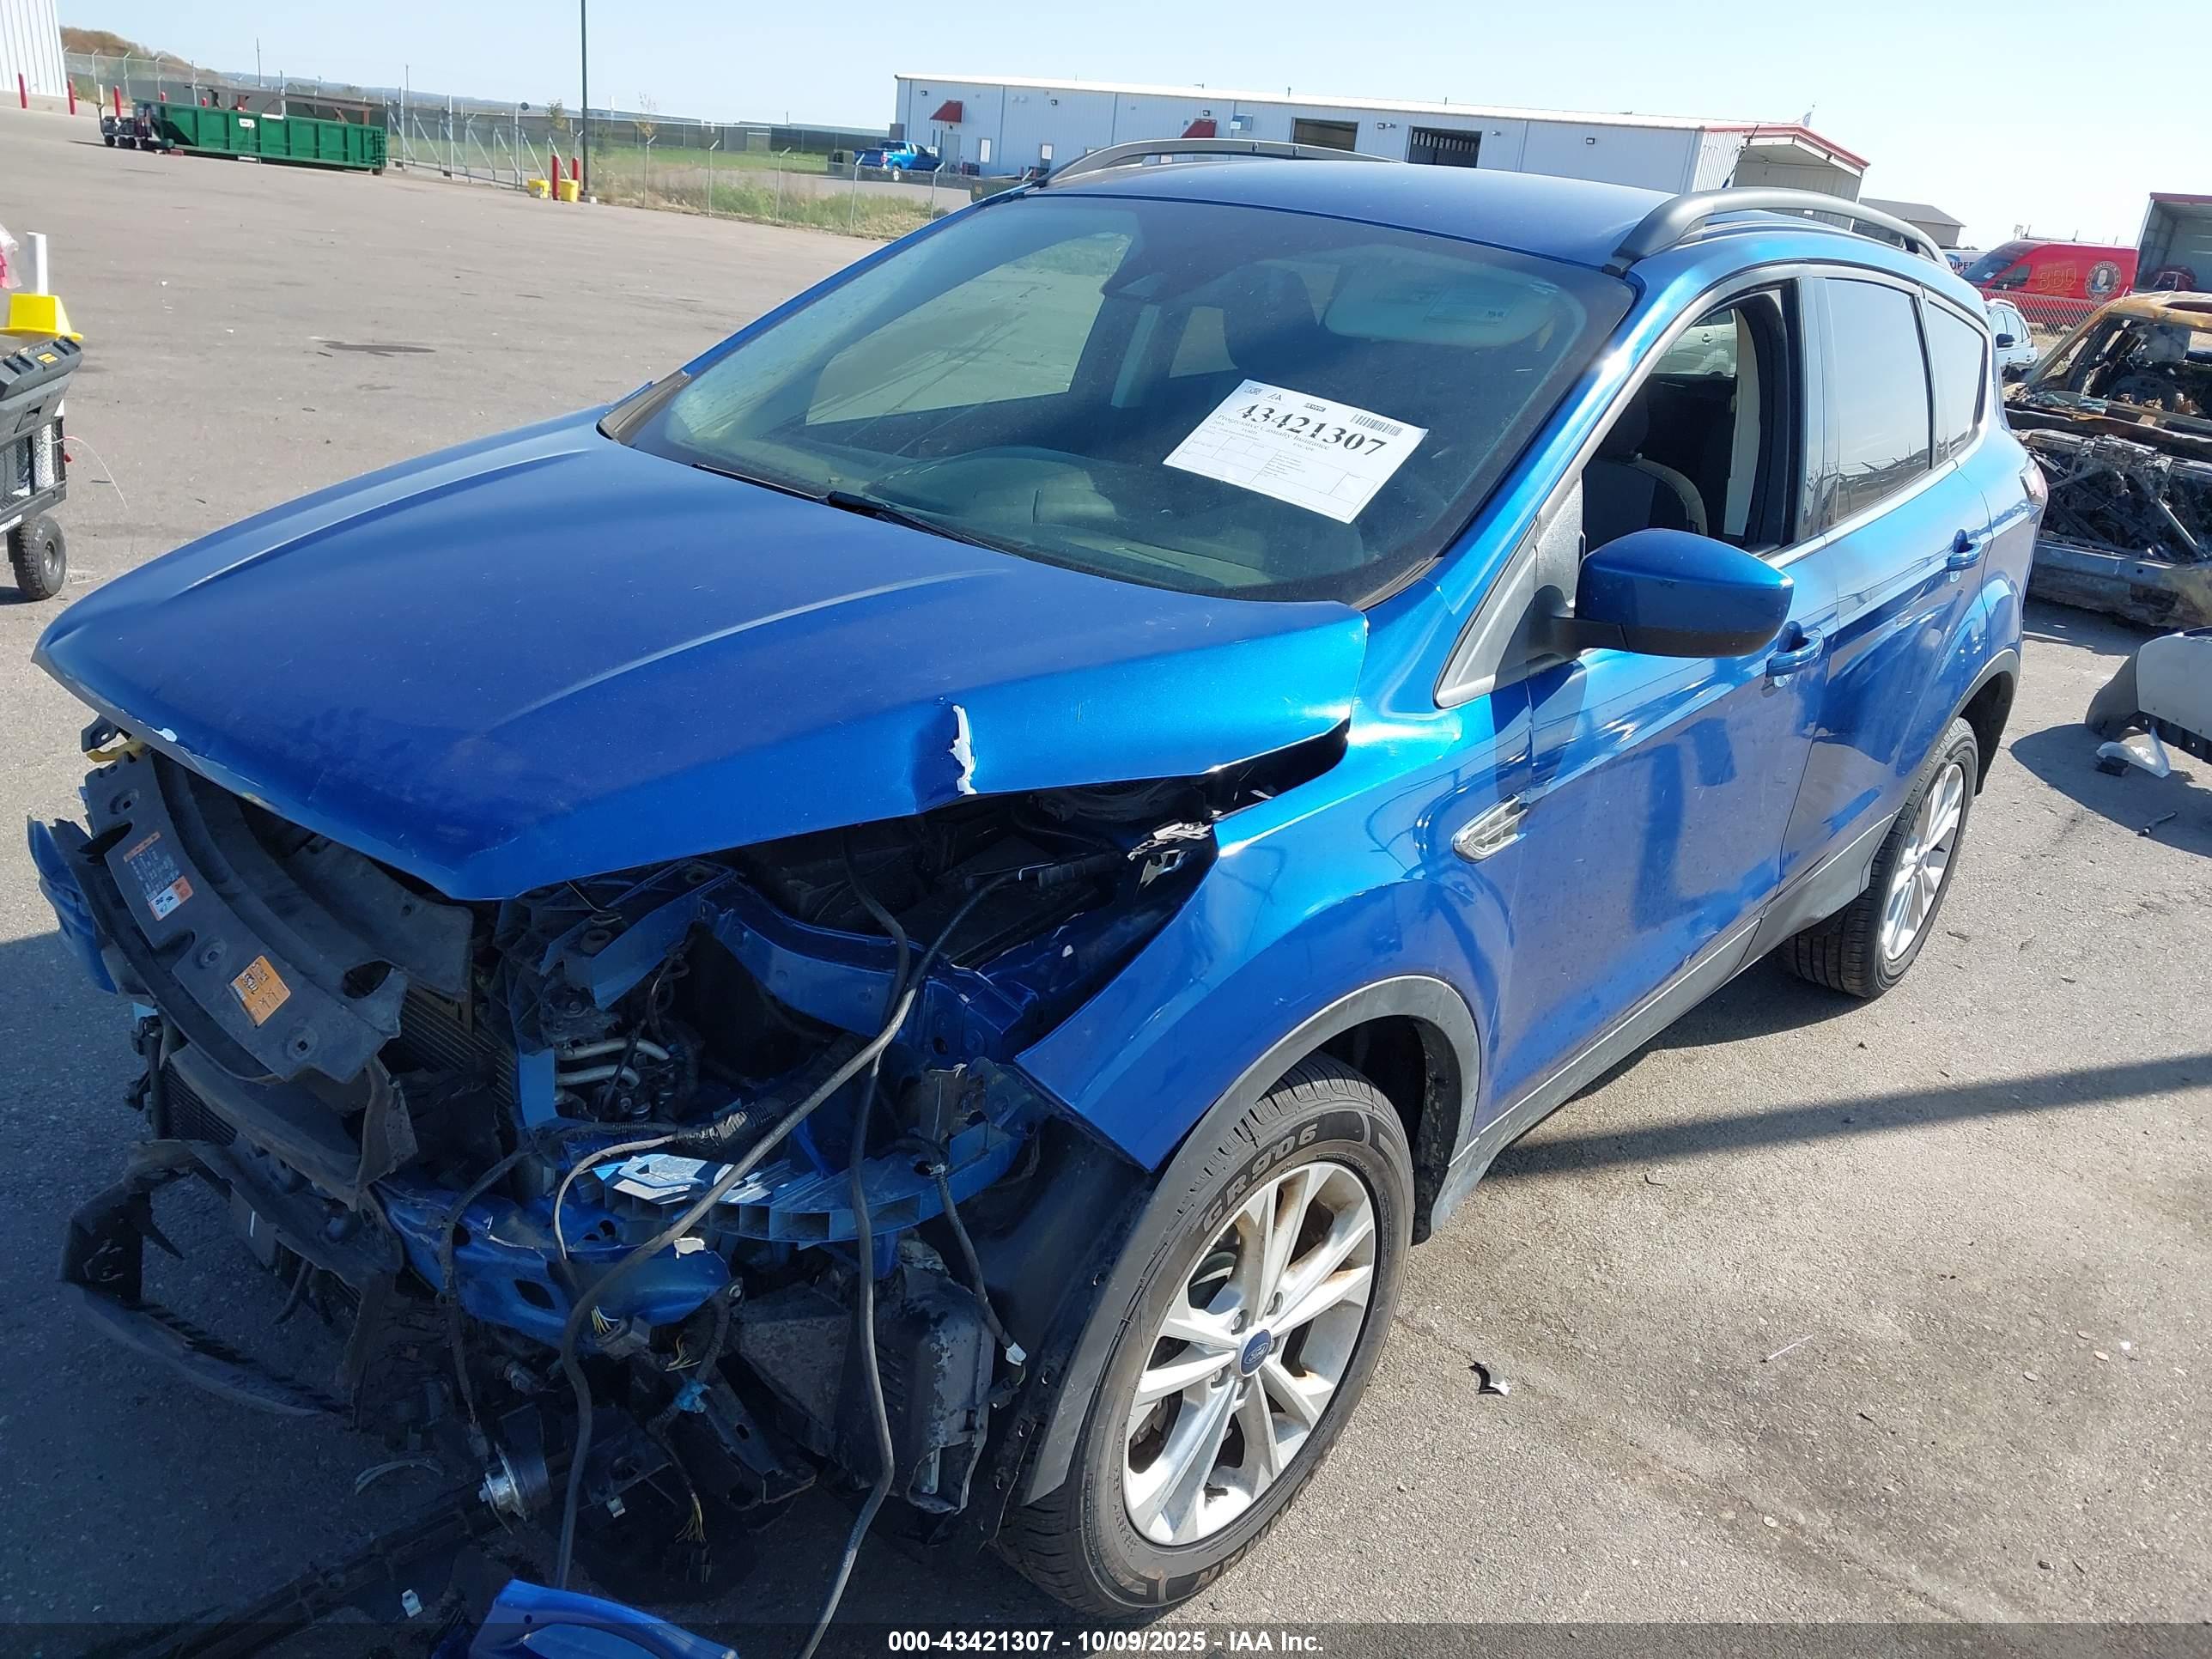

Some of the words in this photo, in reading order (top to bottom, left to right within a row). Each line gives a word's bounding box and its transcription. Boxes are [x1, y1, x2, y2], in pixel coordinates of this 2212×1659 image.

[2037, 267, 2076, 291] BBQ
[1217, 414, 1260, 430] Progressive
[1260, 425, 1292, 440] Casualty
[1293, 434, 1330, 451] Insurance
[1236, 404, 1388, 456] 43421307
[1249, 1346, 1266, 1362] Ford
